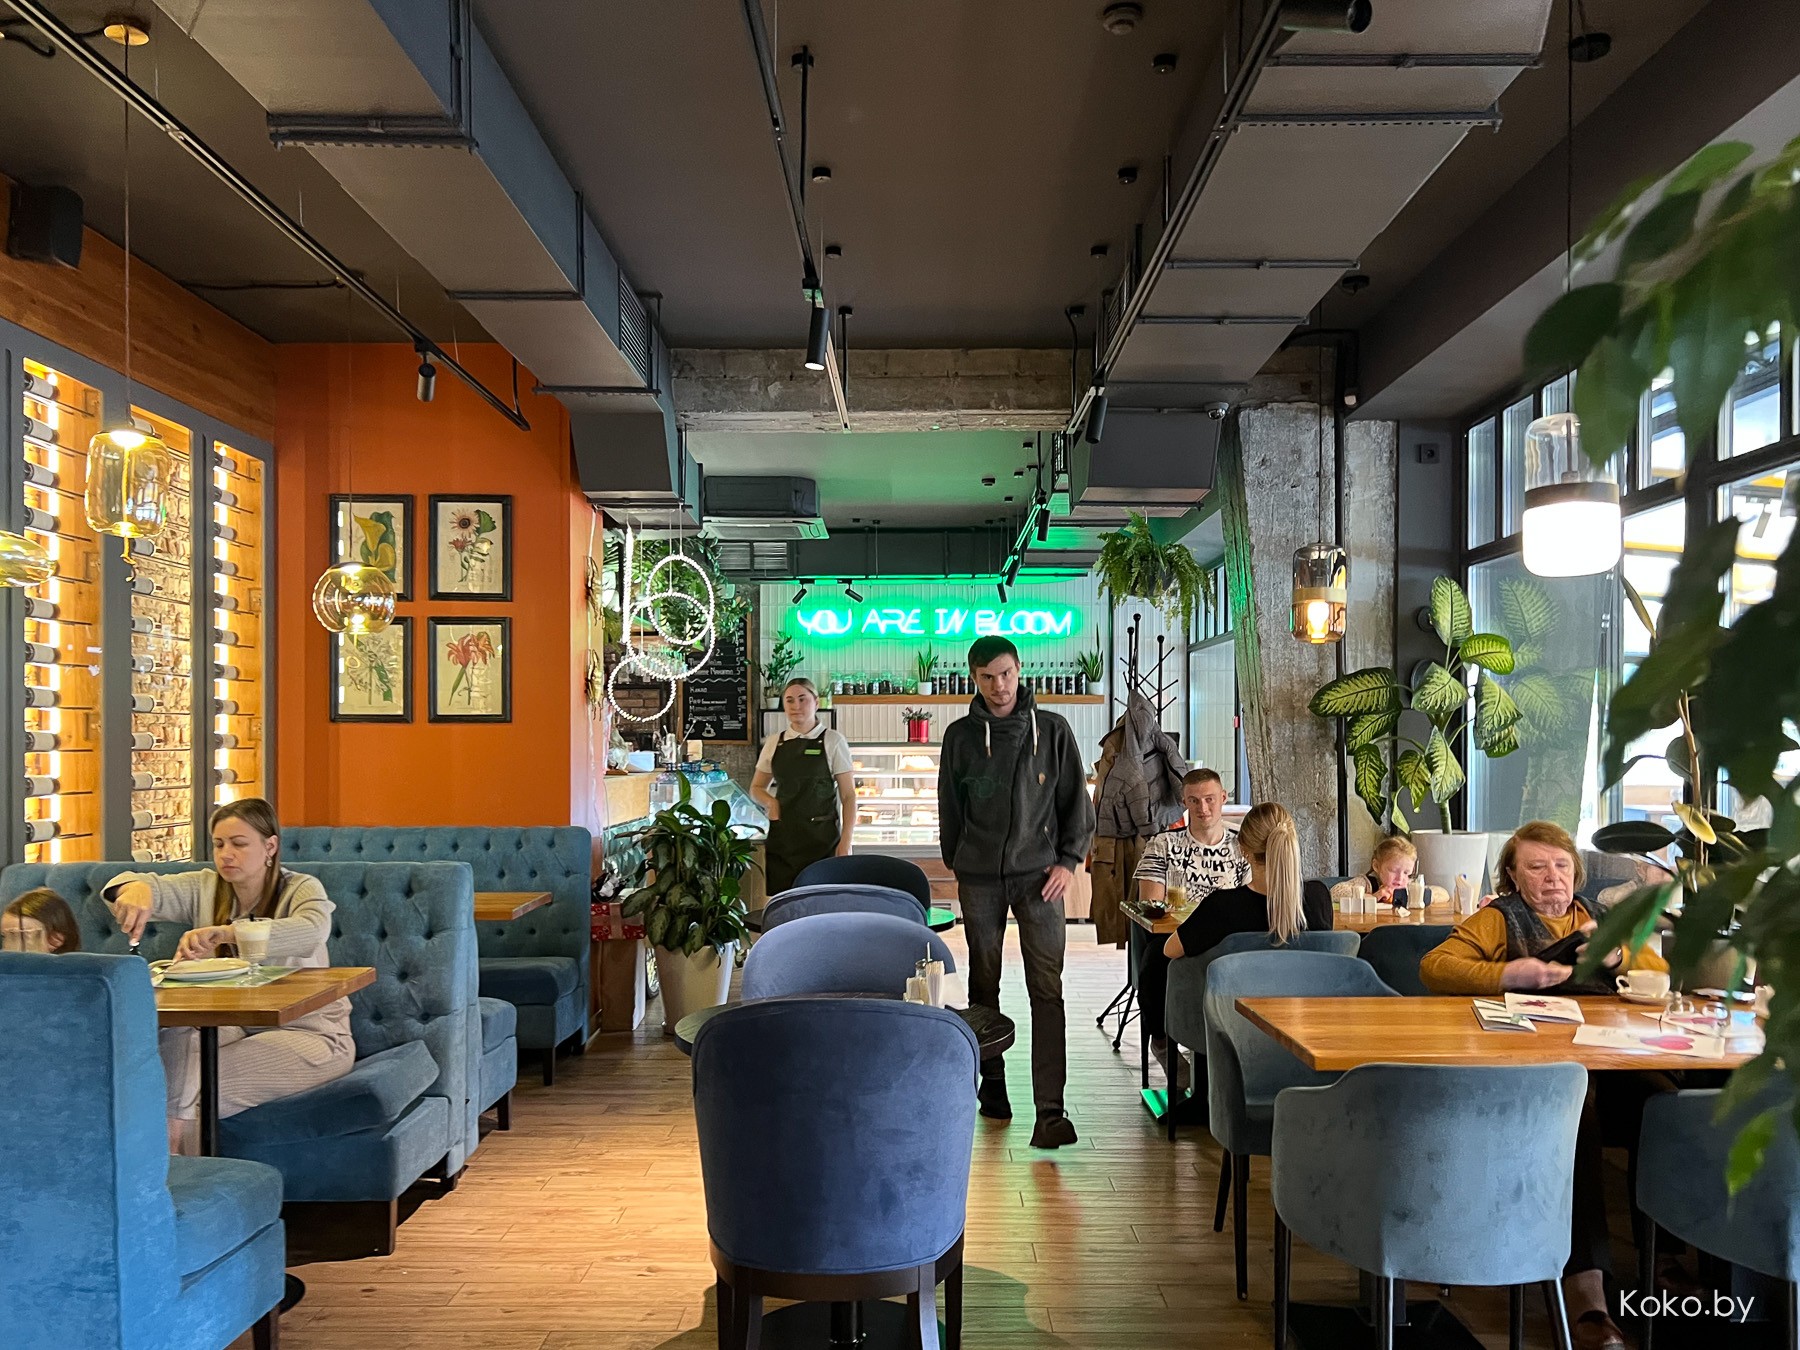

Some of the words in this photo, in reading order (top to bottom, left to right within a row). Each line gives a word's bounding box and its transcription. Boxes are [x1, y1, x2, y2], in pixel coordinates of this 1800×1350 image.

[797, 608, 852, 635] YOU
[861, 608, 925, 635] ARE
[934, 608, 968, 635] IN
[974, 608, 1073, 636] BLOOM
